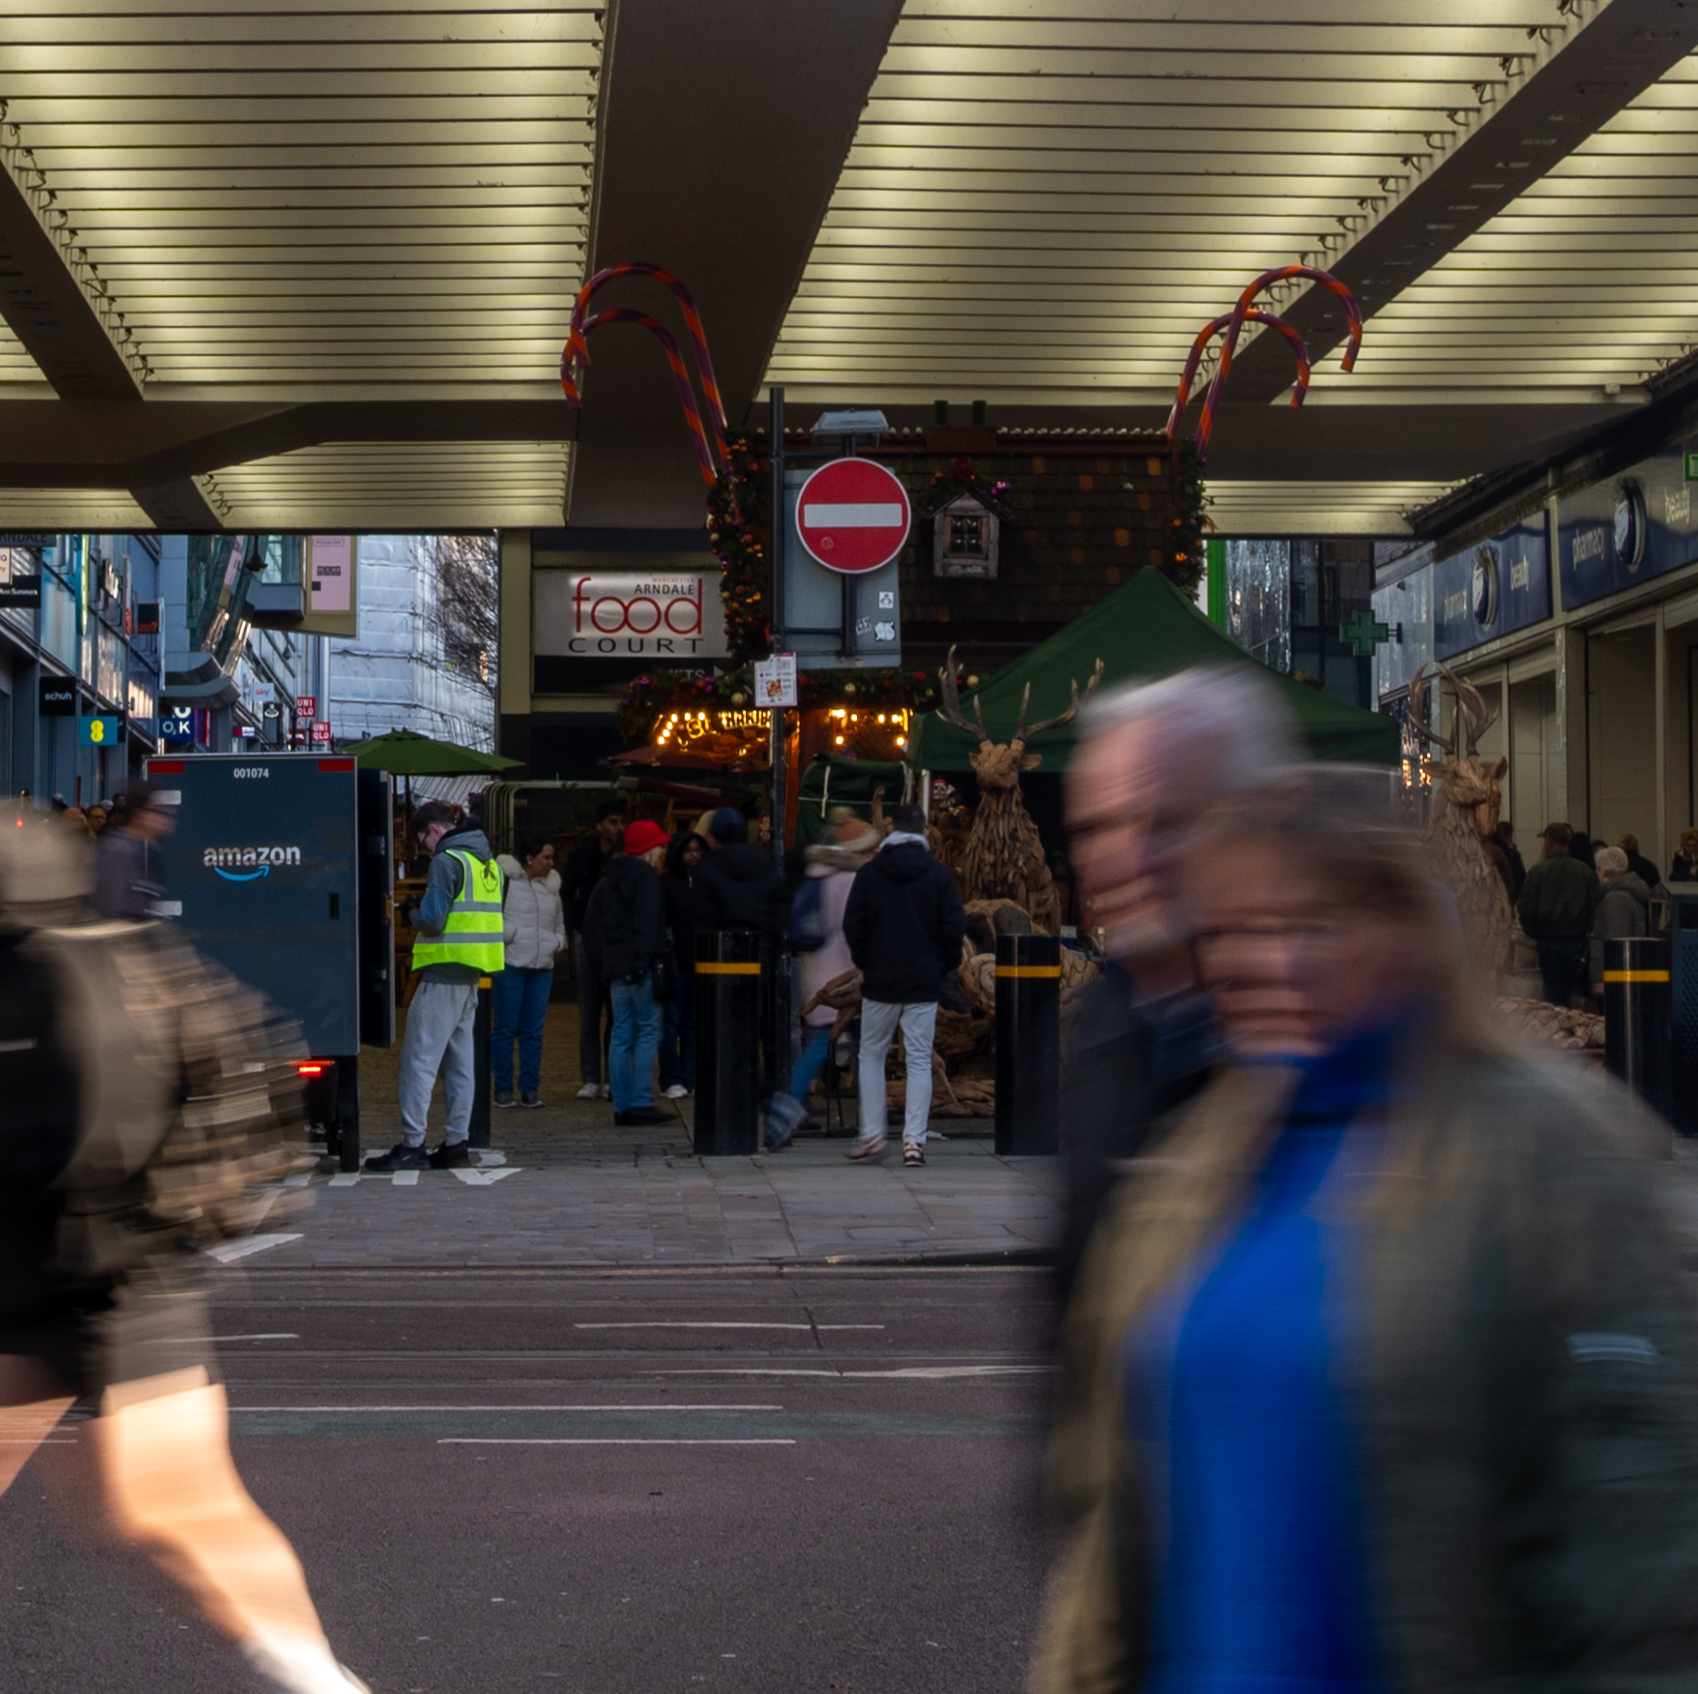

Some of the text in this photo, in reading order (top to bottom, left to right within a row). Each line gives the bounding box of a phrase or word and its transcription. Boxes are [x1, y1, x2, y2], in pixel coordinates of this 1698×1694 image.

[1573, 528, 1604, 571] pharmacy
[634, 584, 694, 595] ARNDALE
[571, 577, 702, 635] food
[568, 637, 704, 654] COURT
[44, 691, 72, 700] schuh
[297, 699, 313, 707] UNI
[233, 767, 270, 779] 001074
[203, 846, 301, 866] amazon
